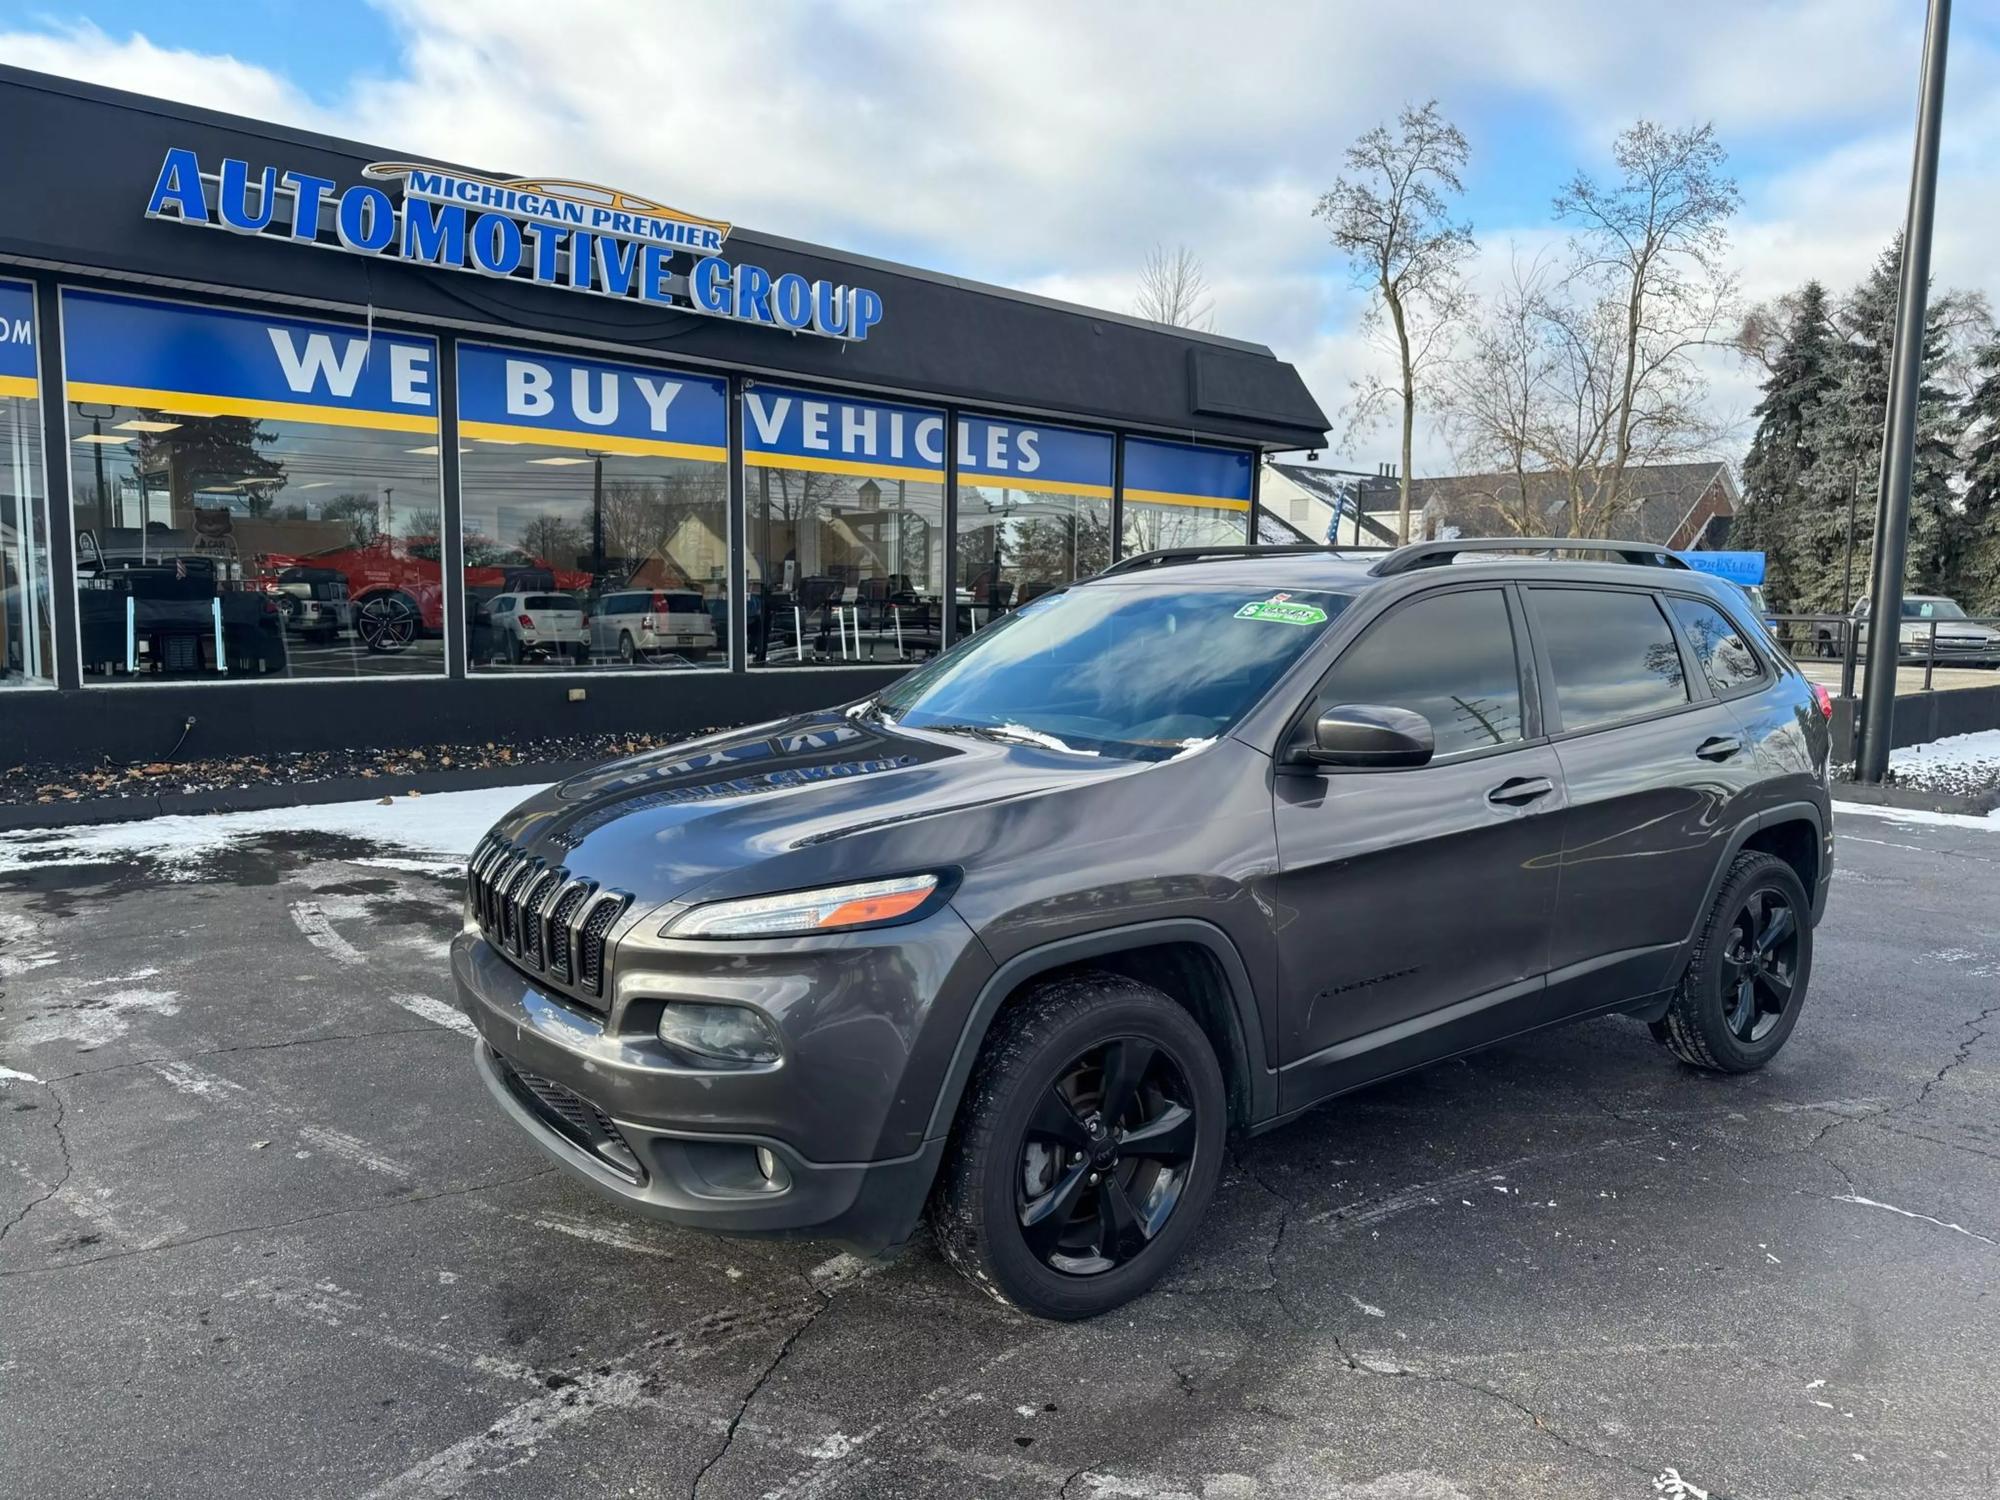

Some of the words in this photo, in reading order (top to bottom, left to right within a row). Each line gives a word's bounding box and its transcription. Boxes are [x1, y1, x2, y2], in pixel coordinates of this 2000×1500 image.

[144, 147, 673, 305] AUTOMOTIVE
[689, 256, 883, 341] GROUP
[409, 170, 585, 224] MICHIGAN
[592, 210, 721, 250] PREMIER
[267, 328, 431, 406] WE
[506, 359, 683, 432] BUY
[745, 393, 1041, 473] VEHICLES
